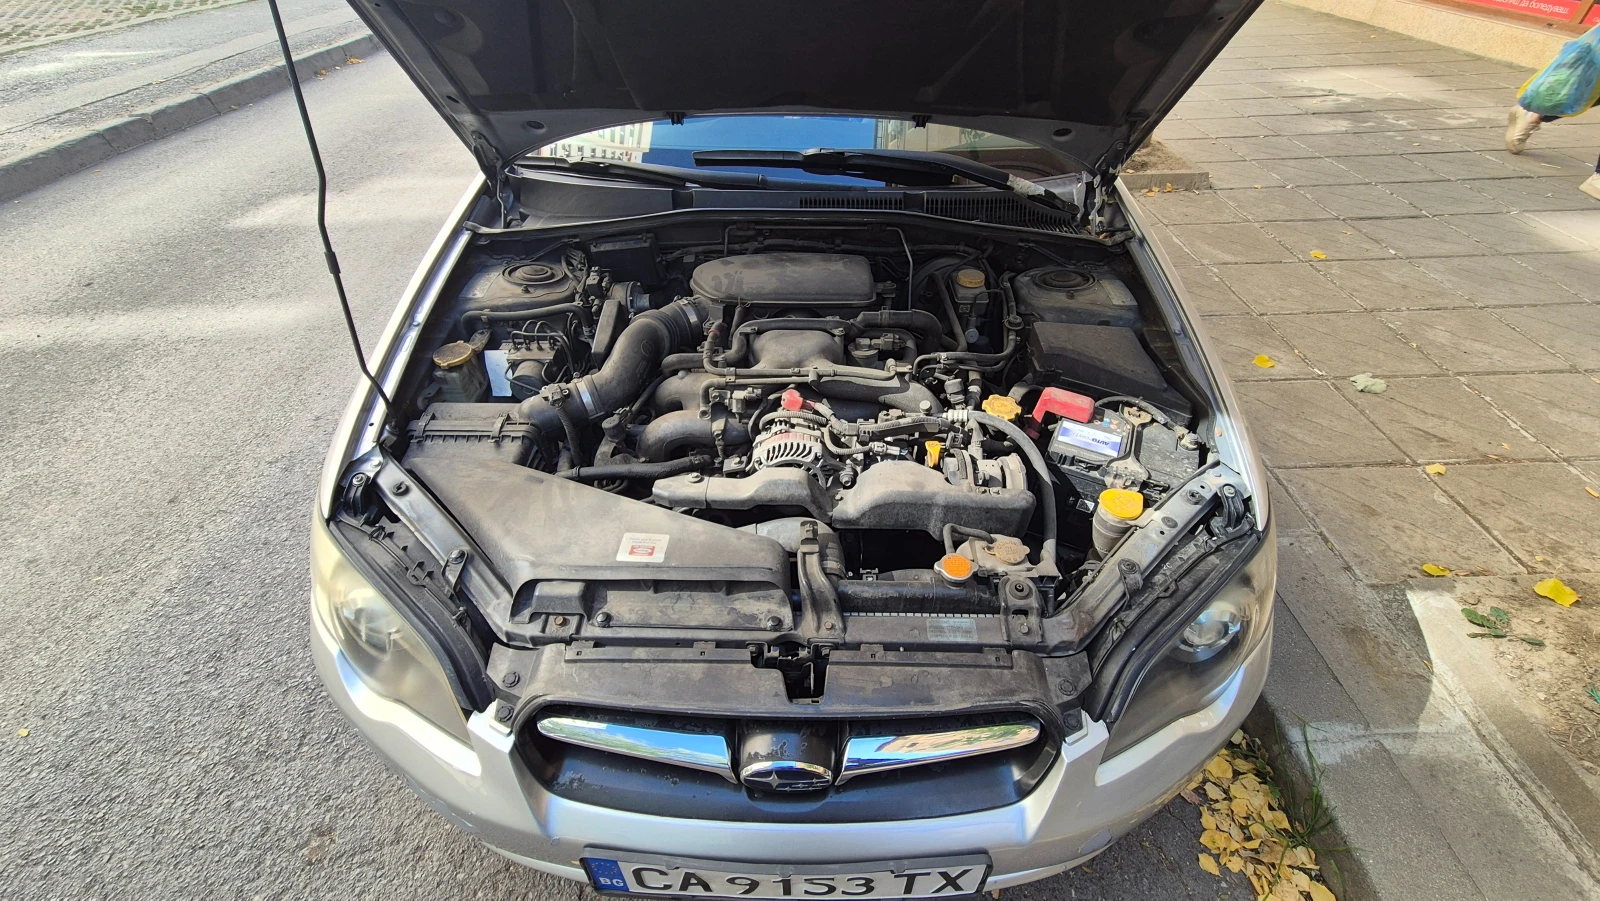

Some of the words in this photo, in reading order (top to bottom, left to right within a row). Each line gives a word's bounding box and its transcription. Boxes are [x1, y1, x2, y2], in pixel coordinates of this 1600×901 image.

[599, 877, 624, 887] BG
[631, 867, 713, 892] CA
[726, 876, 875, 896] 9153
[894, 868, 973, 895] TX
